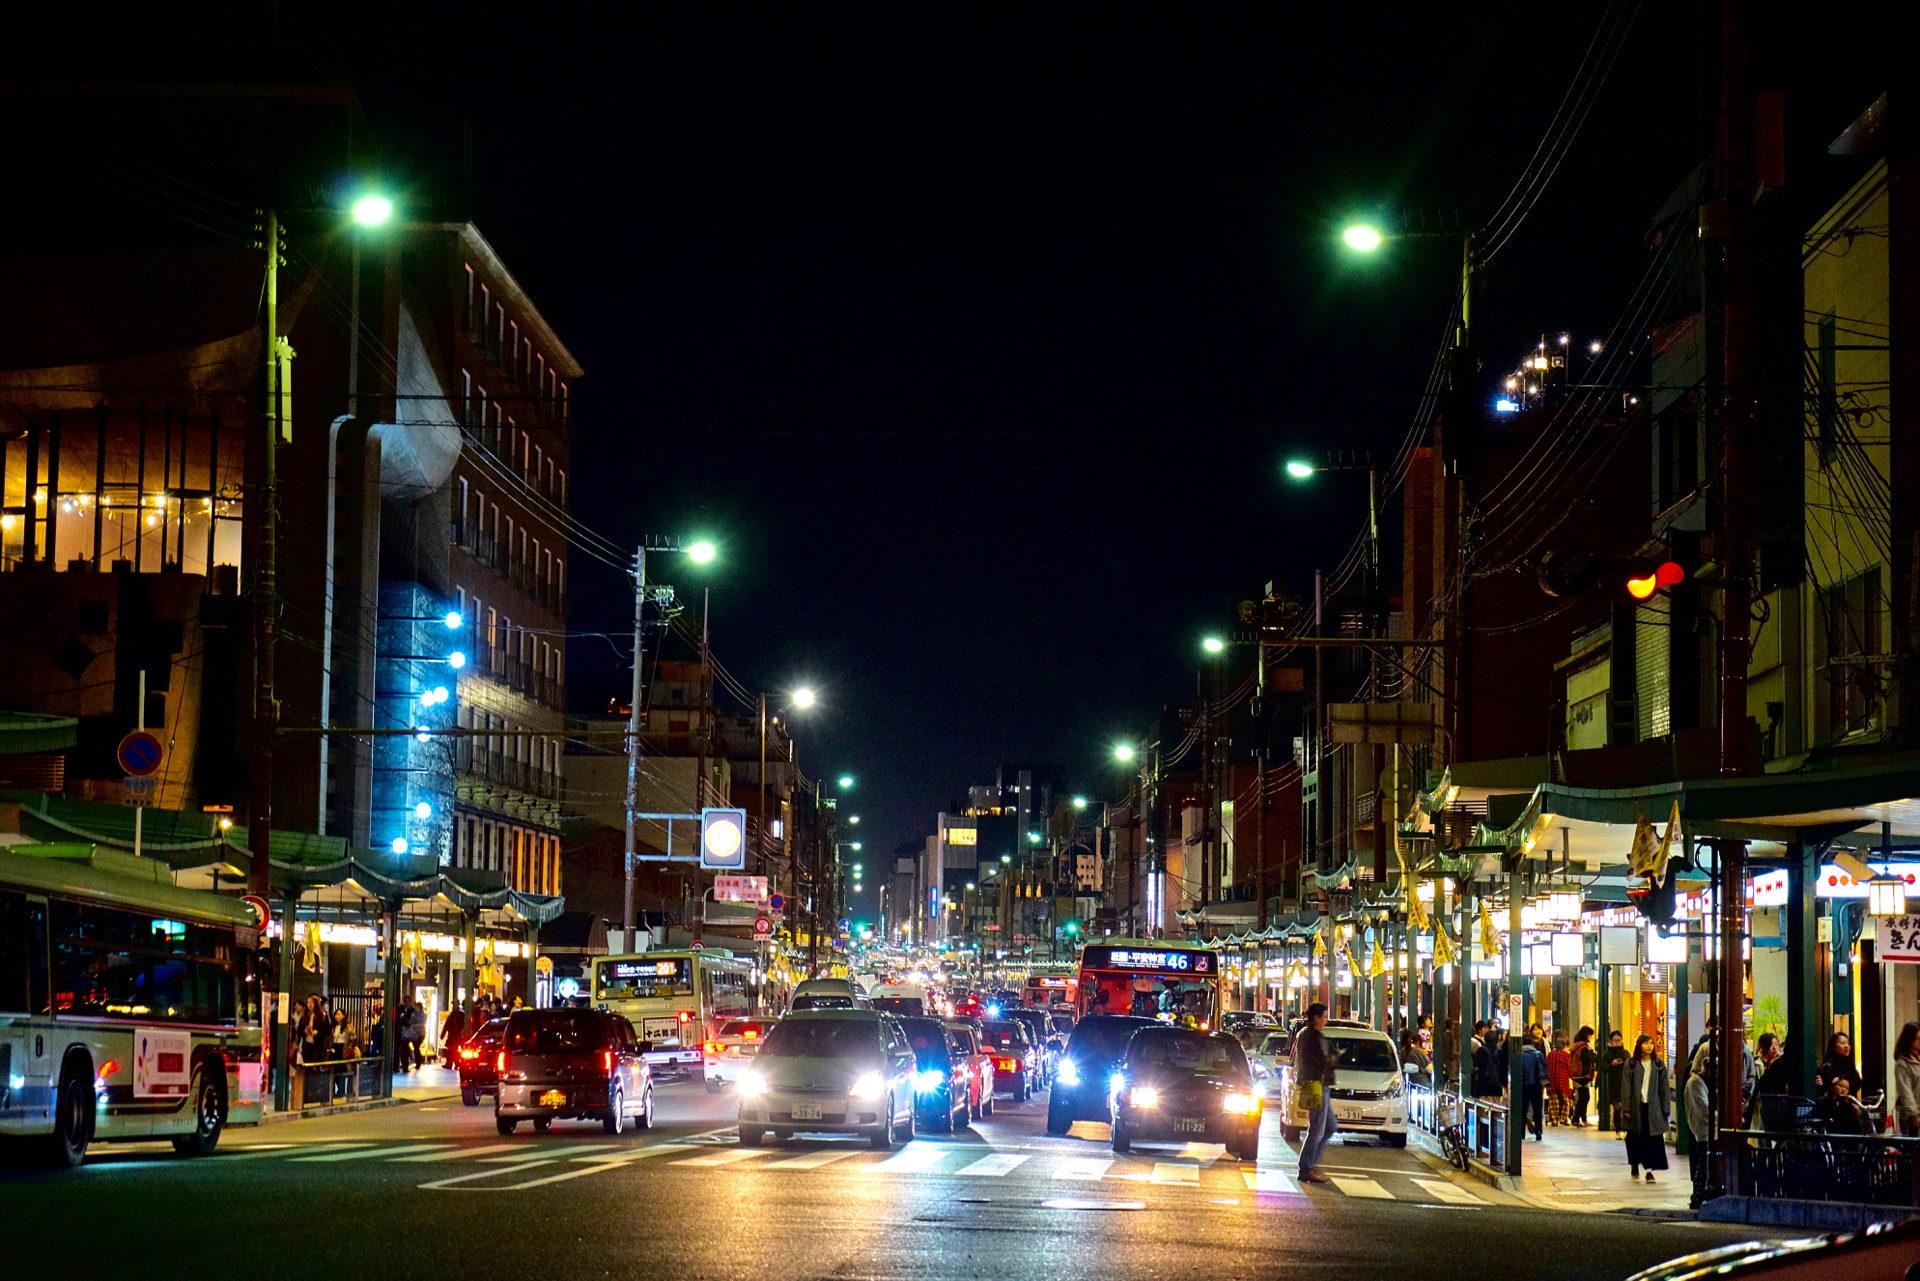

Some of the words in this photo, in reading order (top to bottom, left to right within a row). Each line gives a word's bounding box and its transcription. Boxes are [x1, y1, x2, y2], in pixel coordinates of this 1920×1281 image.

[1167, 954, 1188, 970] 46
[657, 962, 674, 975] 201
[798, 1109, 821, 1118] 38-74
[1181, 1122, 1202, 1132] 11-22
